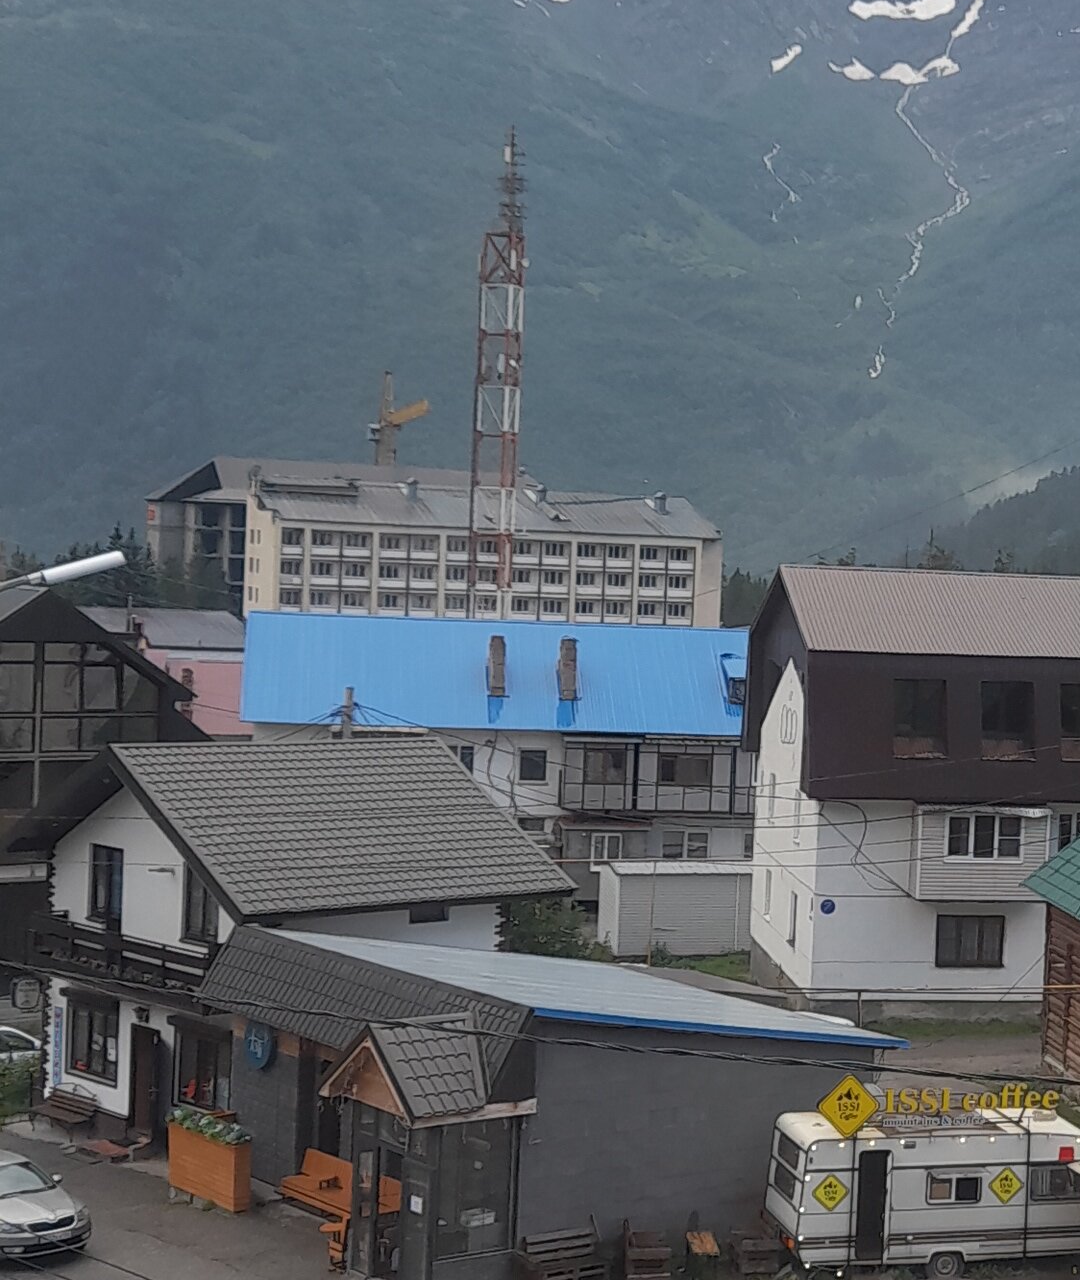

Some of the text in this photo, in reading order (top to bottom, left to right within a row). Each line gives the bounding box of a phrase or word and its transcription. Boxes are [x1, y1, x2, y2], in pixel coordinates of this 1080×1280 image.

[837, 1102, 860, 1112] ISSI
[885, 1083, 1059, 1114] ISSI coffee
